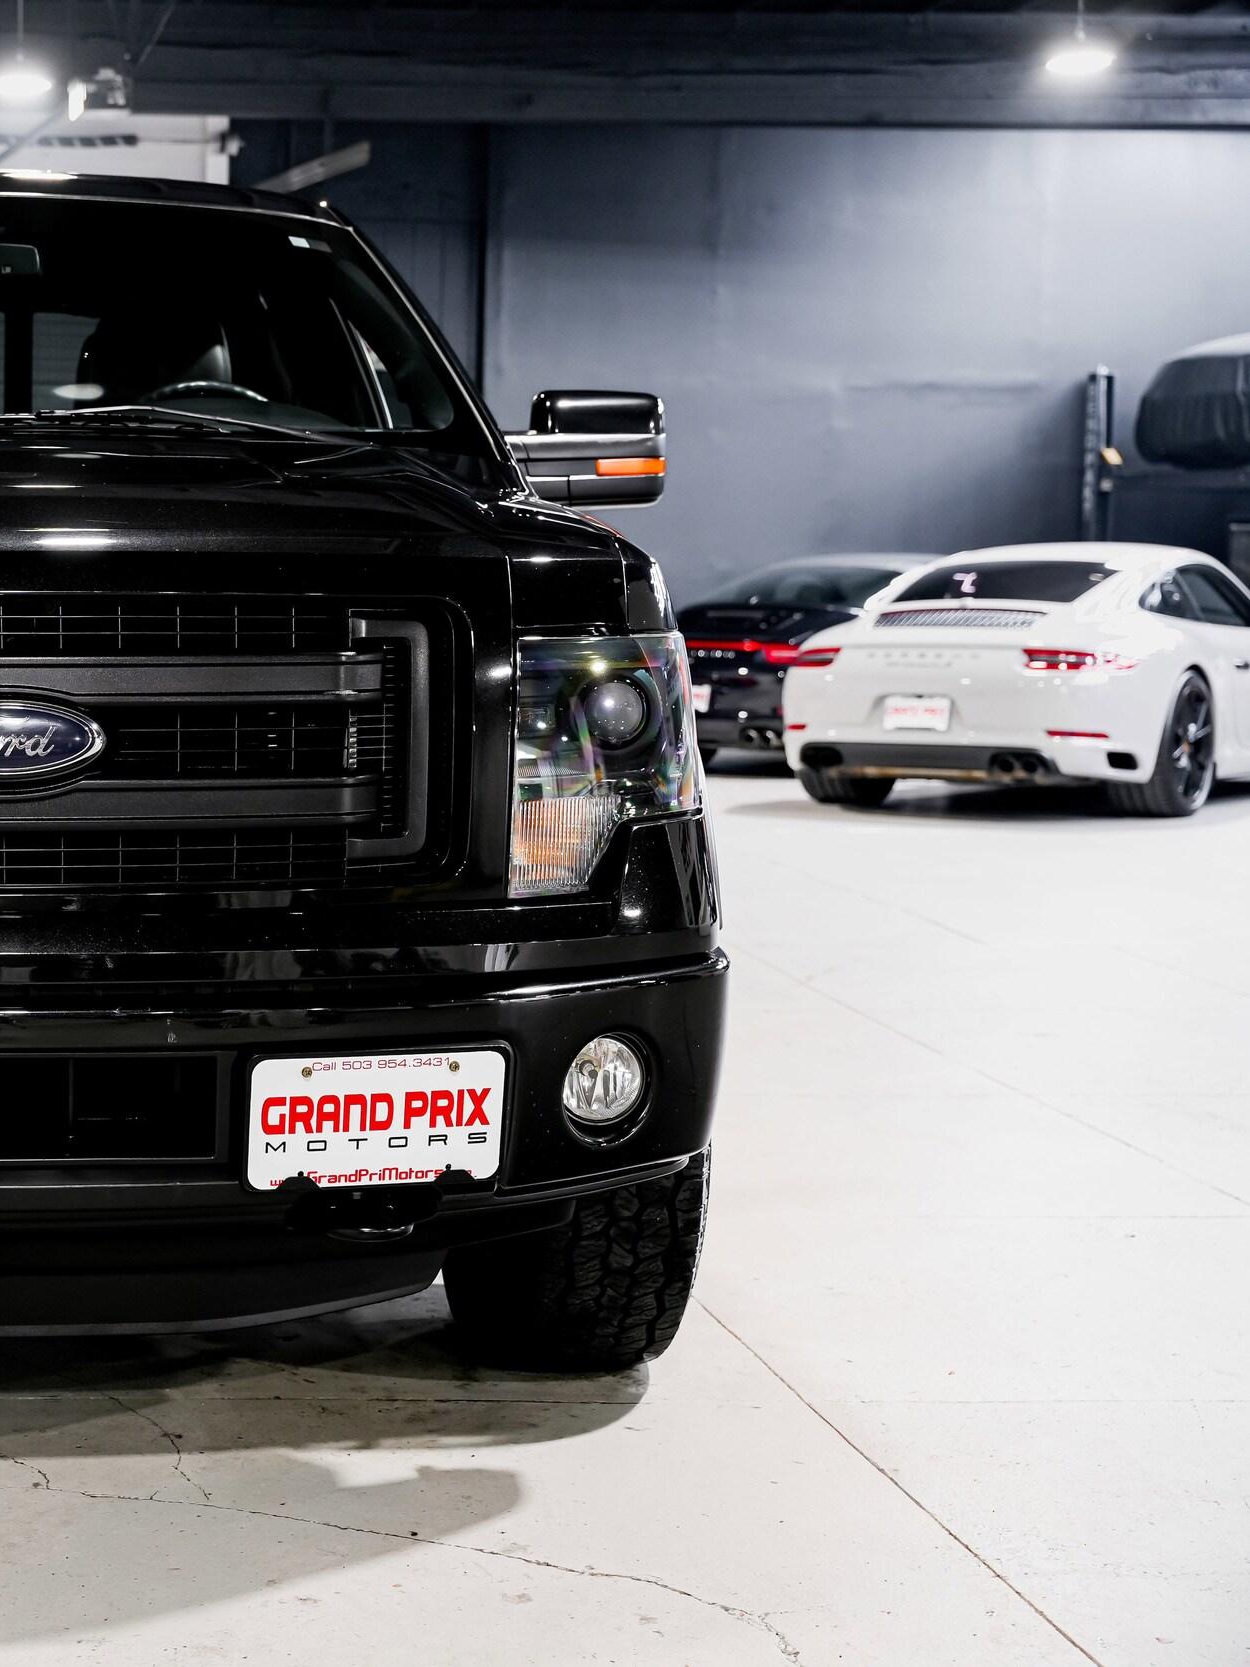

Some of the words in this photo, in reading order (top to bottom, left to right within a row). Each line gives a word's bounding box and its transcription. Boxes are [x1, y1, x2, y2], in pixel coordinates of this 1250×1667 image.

[311, 1061, 337, 1072] Call
[341, 1060, 373, 1071] 503
[377, 1056, 450, 1070] 954.3431
[261, 1093, 394, 1135] GRAND
[403, 1087, 492, 1130] PRIX
[265, 1132, 488, 1153] MOTORS
